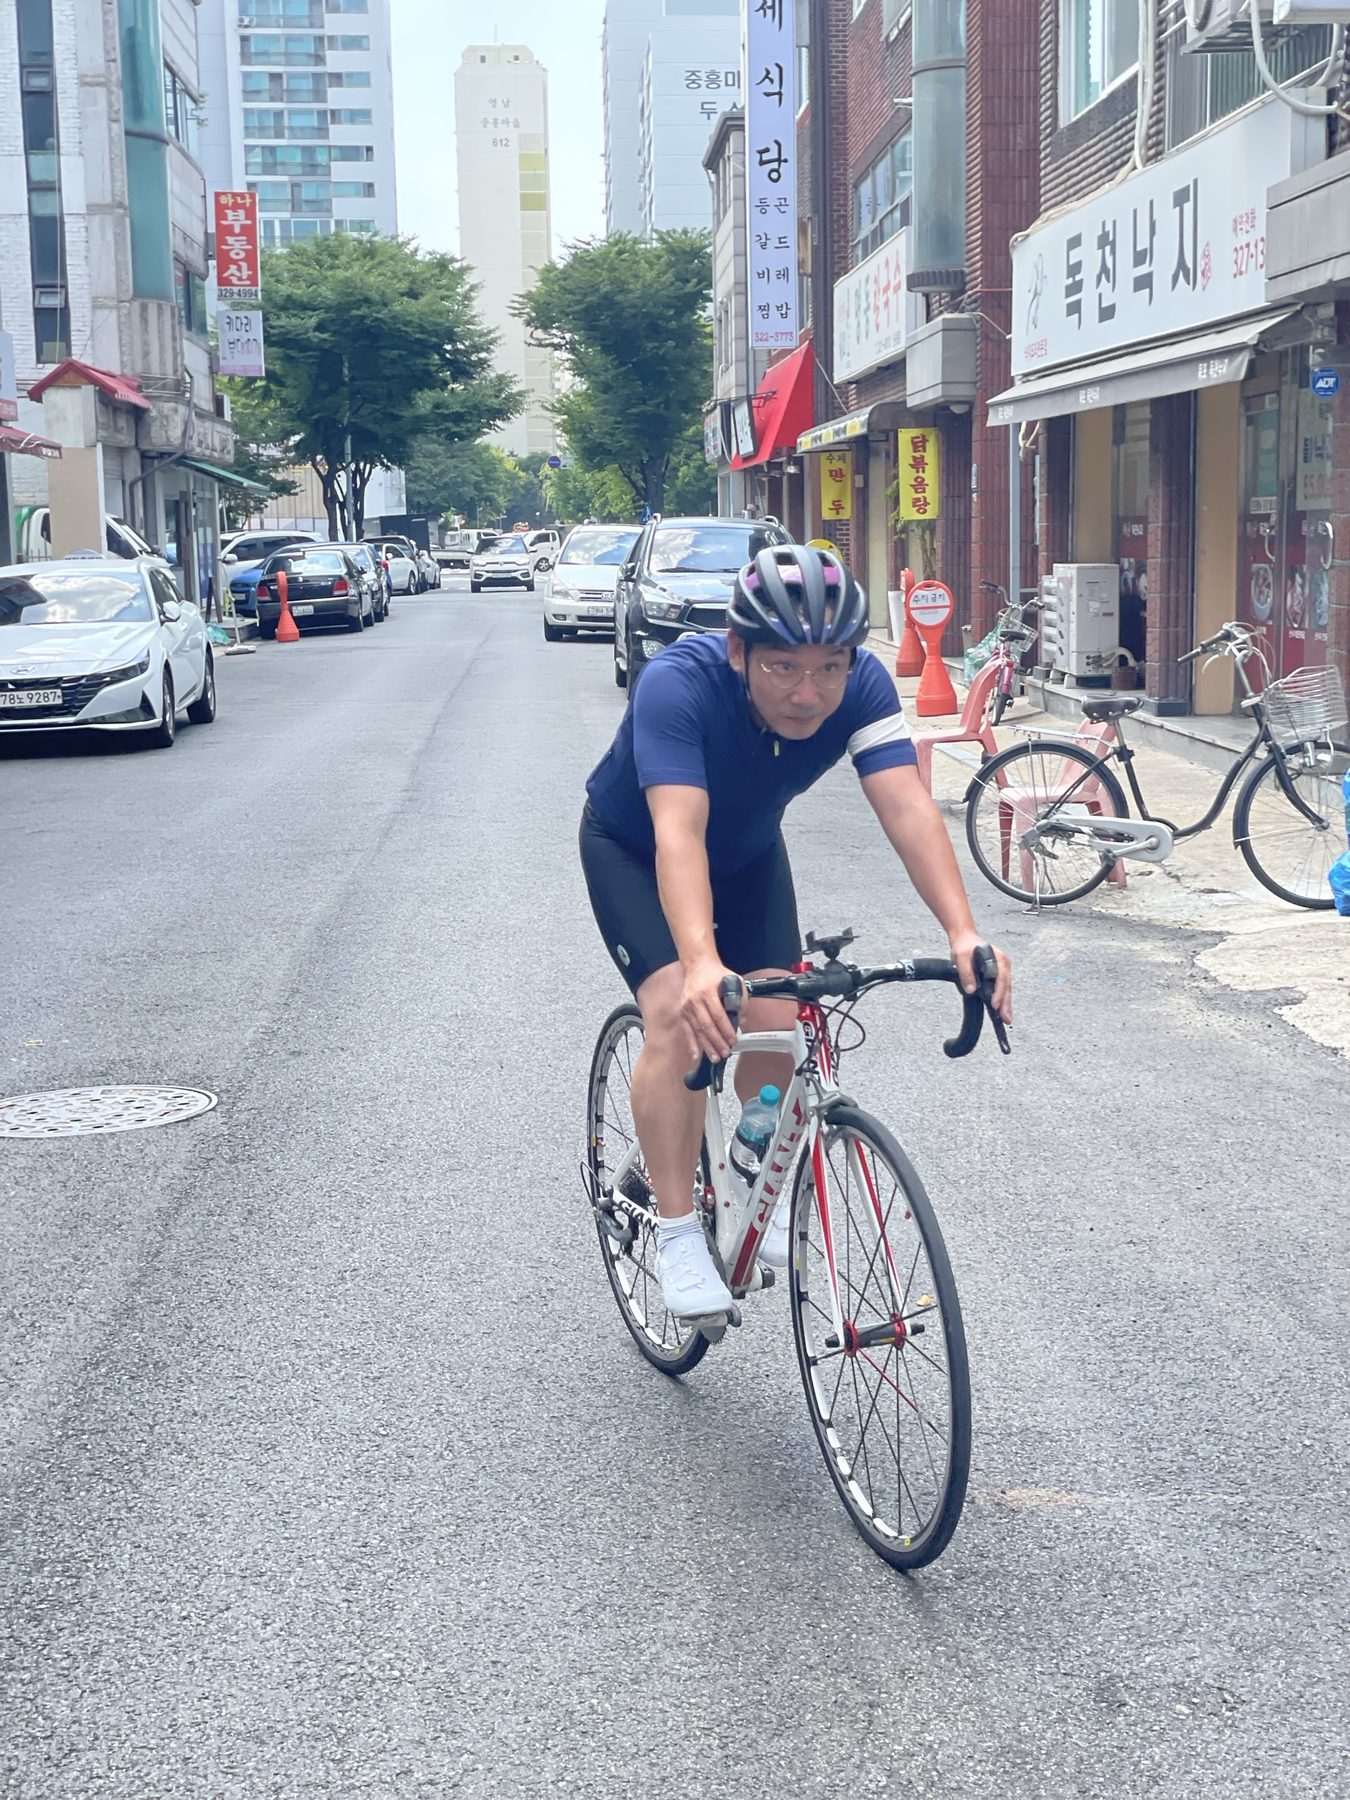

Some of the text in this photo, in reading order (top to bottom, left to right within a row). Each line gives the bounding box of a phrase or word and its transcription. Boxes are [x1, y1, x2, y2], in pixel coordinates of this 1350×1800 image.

[492, 137, 511, 148] 612
[219, 193, 252, 208] 하나
[220, 209, 253, 285] 부동산
[1064, 177, 1199, 331] 독천낙지
[754, 197, 771, 320] 등갈비찜
[773, 197, 791, 319] 곤드레밥
[218, 288, 258, 298] 329-4994
[754, 331, 794, 342] 322-3773
[1315, 377, 1337, 388] ADT
[828, 468, 846, 515] 만두
[26, 691, 57, 704] 9287
